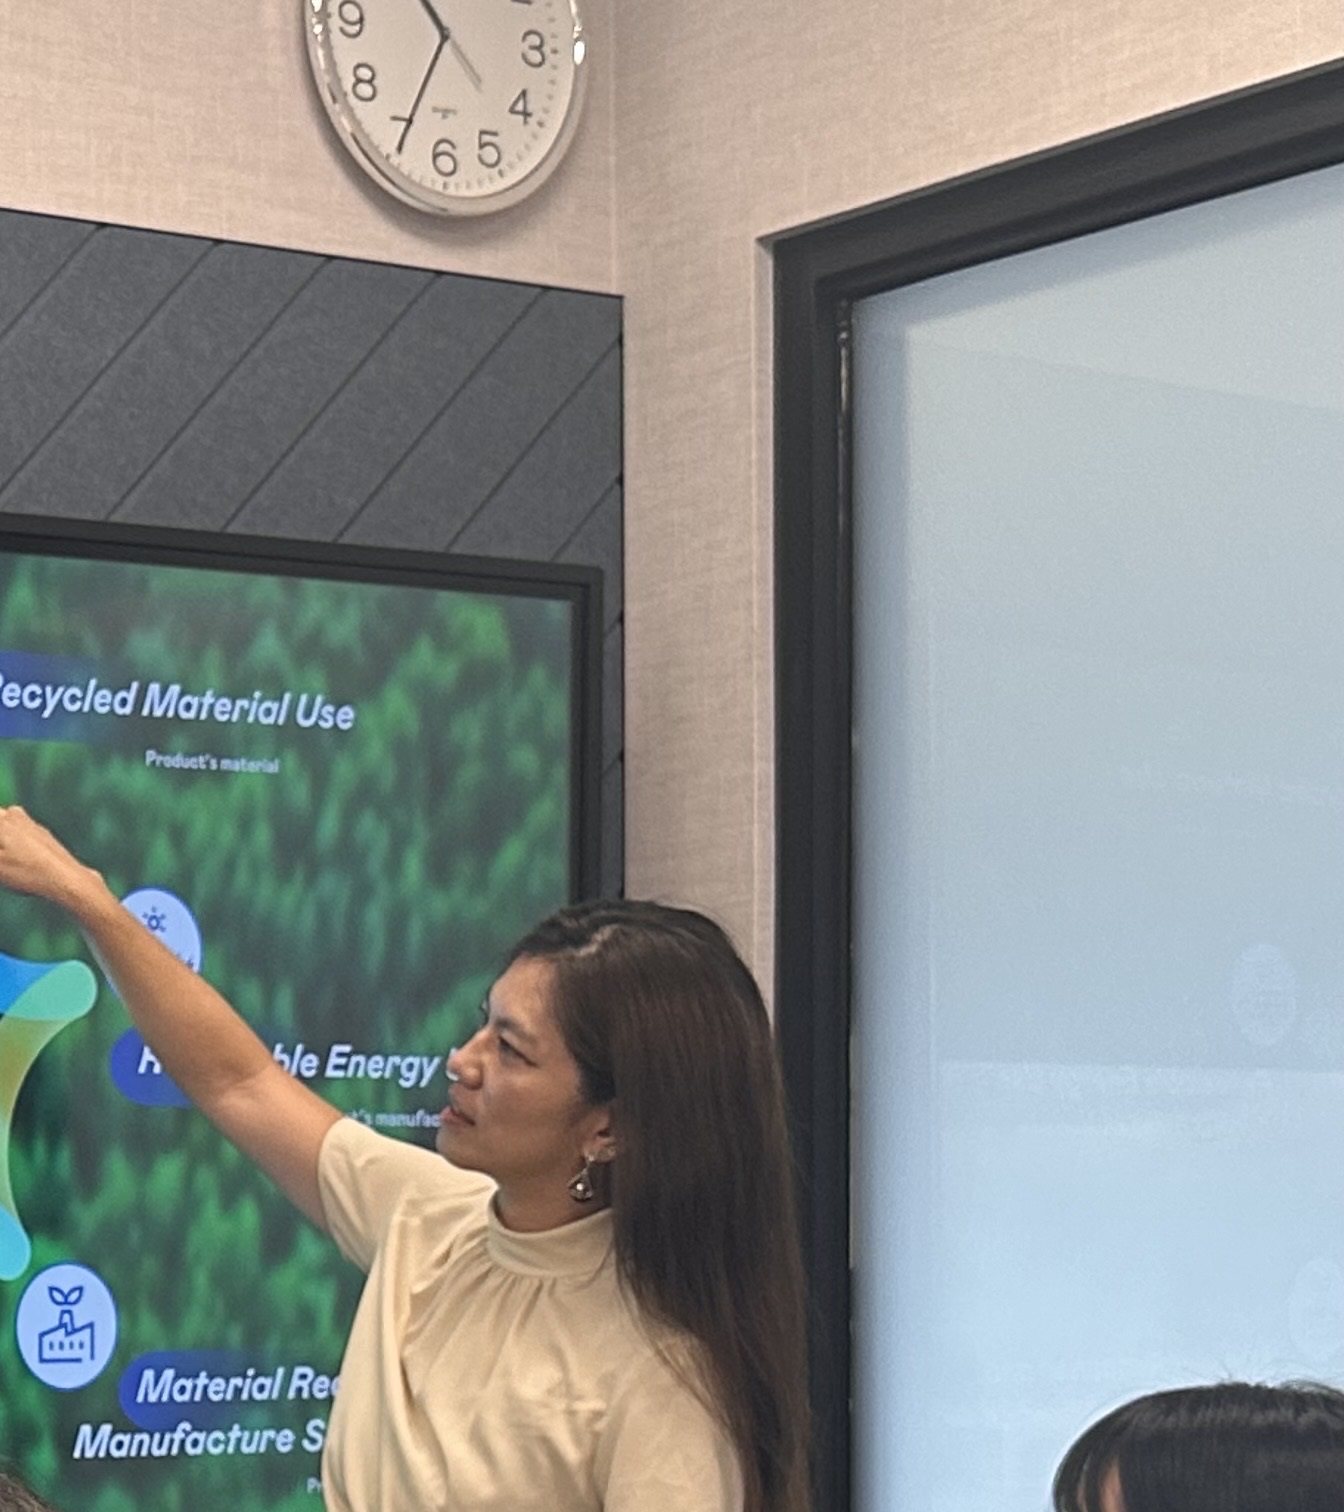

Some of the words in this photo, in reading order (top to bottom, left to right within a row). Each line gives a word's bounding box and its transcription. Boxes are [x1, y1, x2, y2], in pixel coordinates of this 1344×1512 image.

[338, 0, 364, 38] 9
[521, 30, 546, 68] 3
[352, 62, 377, 102] 8
[508, 89, 533, 125] 4
[432, 138, 458, 177] 6
[477, 130, 502, 168] 5
[141, 683, 290, 726] Material
[296, 697, 355, 731] Use
[145, 749, 217, 771] Product's
[220, 755, 279, 775] material
[324, 1044, 441, 1088] Energy
[375, 1108, 441, 1127] manufac
[136, 1366, 285, 1403] Material
[72, 1420, 295, 1459] Manufacture
